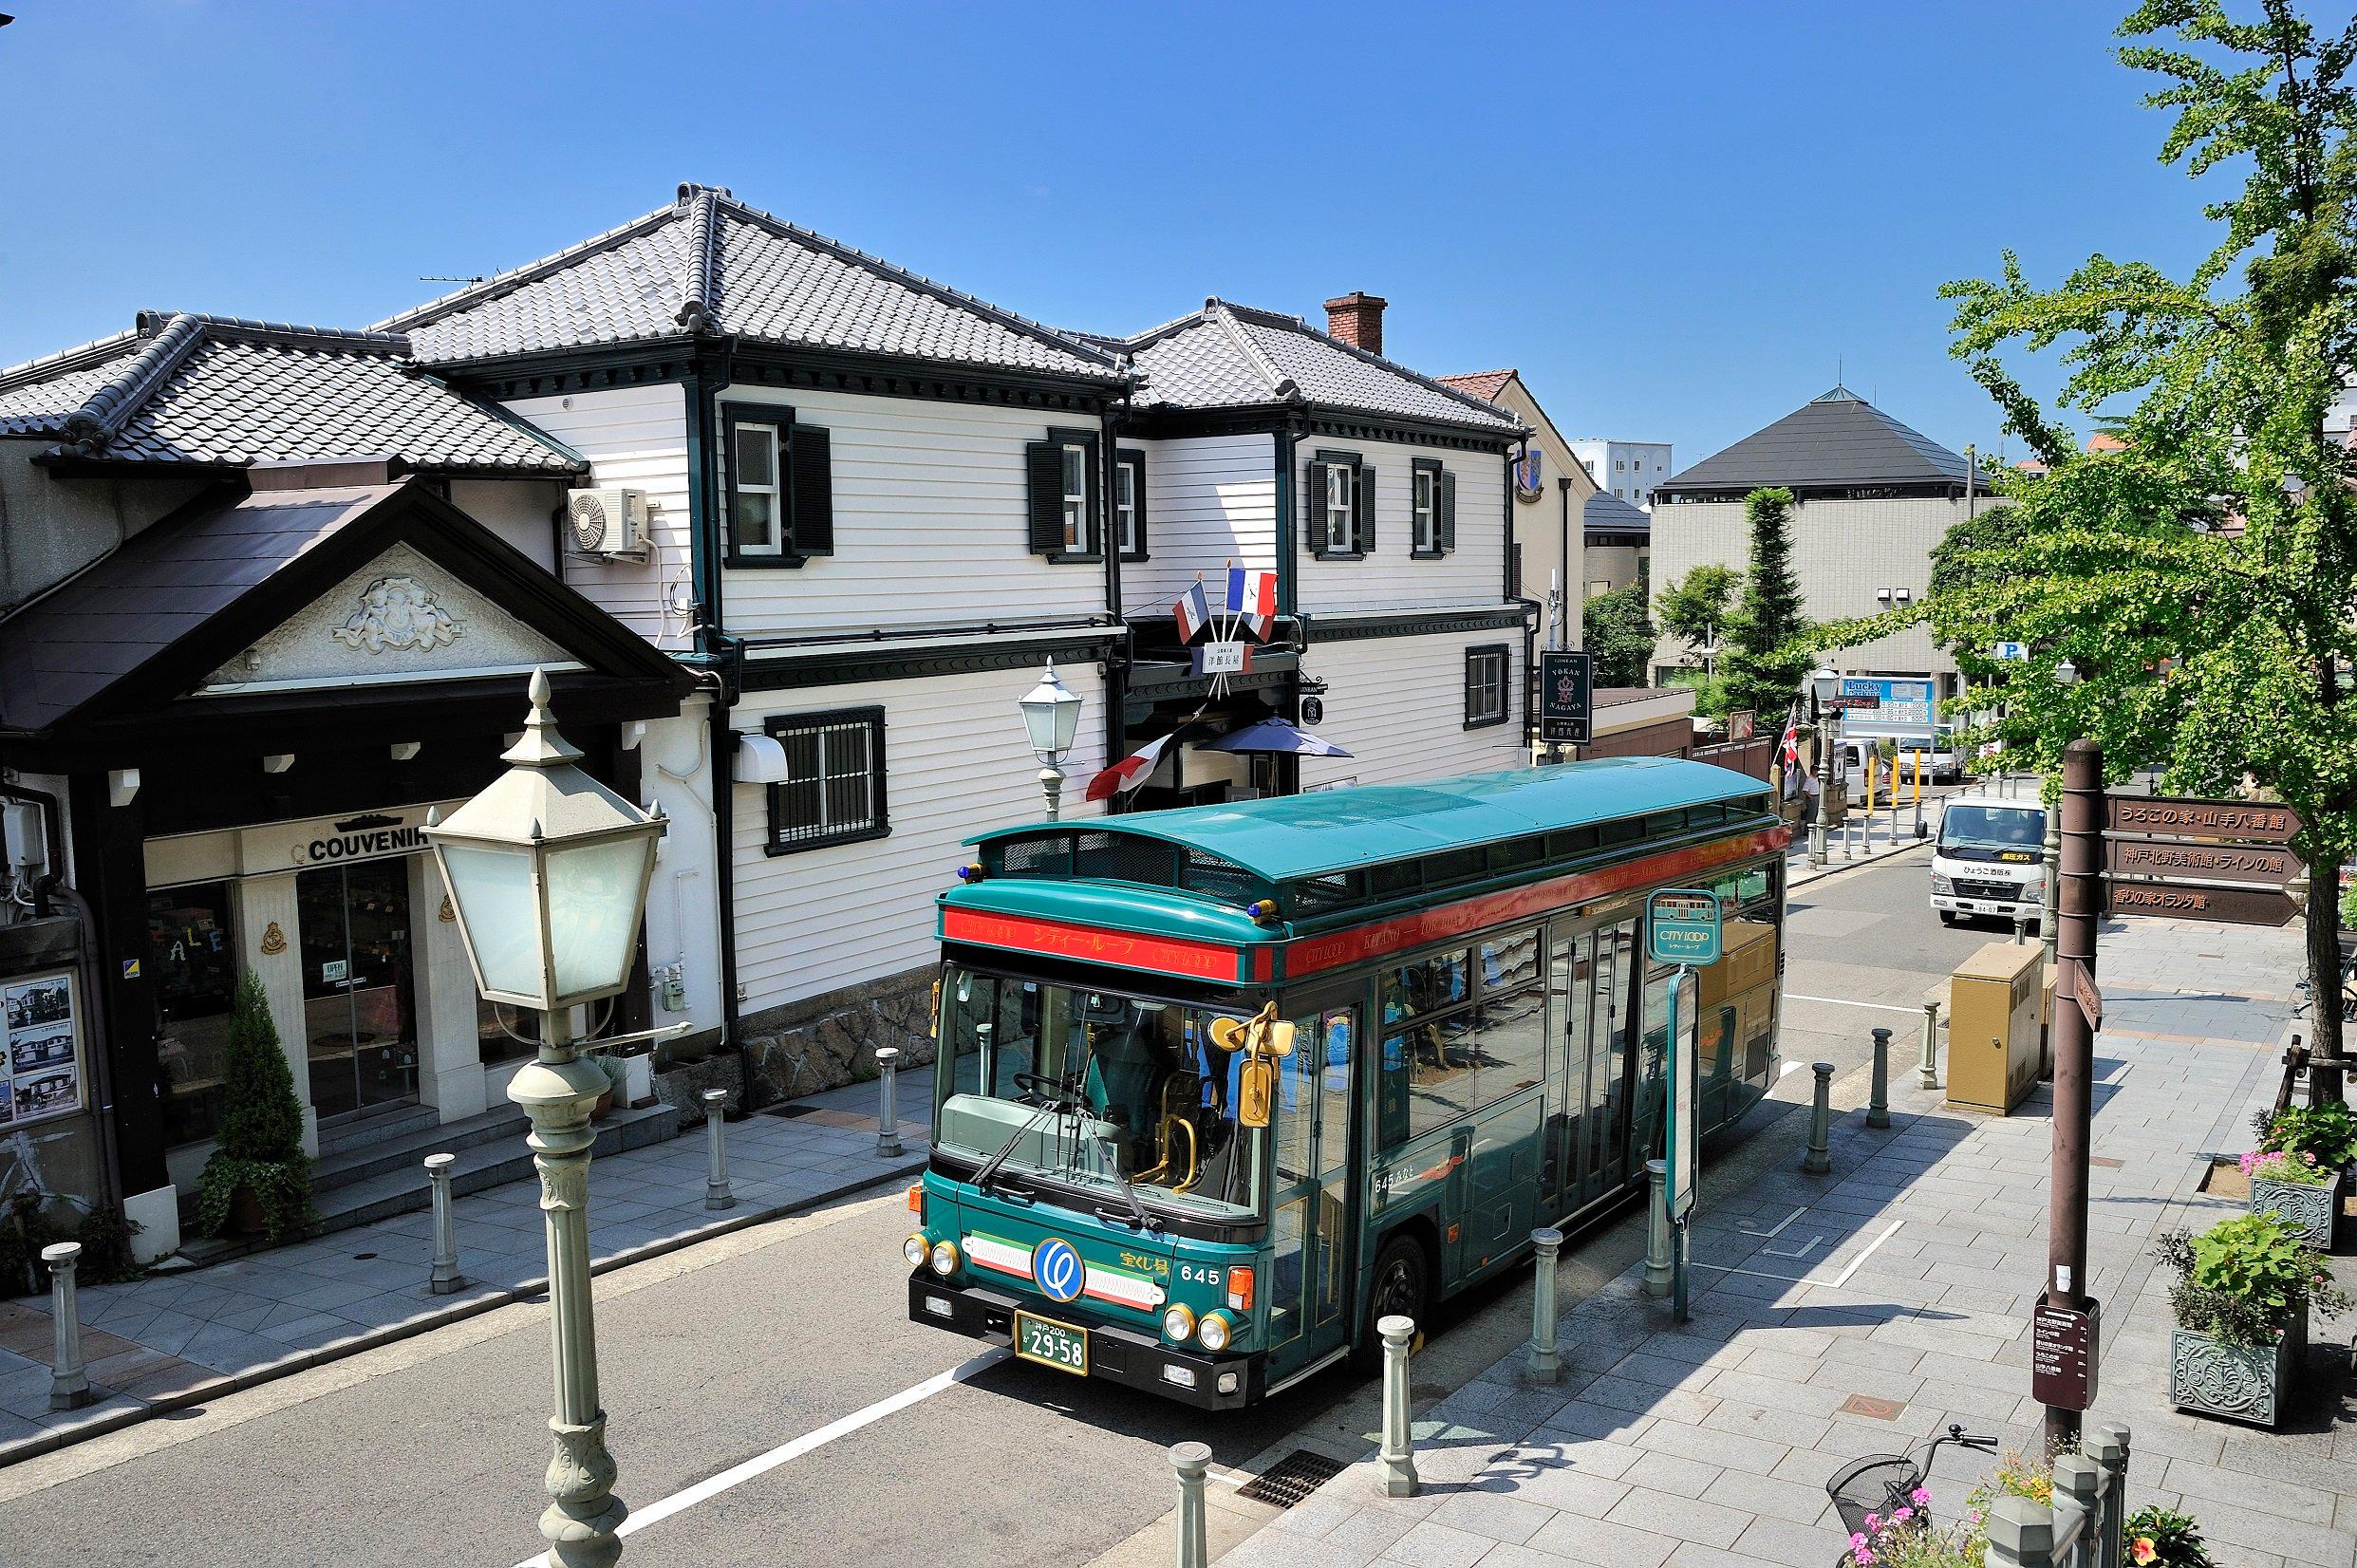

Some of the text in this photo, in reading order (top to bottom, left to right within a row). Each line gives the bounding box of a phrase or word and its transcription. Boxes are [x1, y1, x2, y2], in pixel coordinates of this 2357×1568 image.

[2004, 644, 2018, 657] P
[1848, 681, 1882, 692] Lucky
[1549, 702, 1581, 711] NAGAYA
[2121, 807, 2286, 830] うろこの家・山手八番館
[2123, 848, 2284, 872] 神戸北野美術館・ラインの館
[960, 918, 1018, 940] CITY LOOP
[1364, 927, 1401, 950] KITANO
[1659, 930, 1710, 942] CITY LOOP
[1152, 947, 1217, 969] CITY LOOP
[1375, 1173, 1394, 1193] 645
[1120, 1252, 1169, 1276] 宝くじ号
[1181, 1265, 1220, 1285] 645
[1031, 1330, 1082, 1366] 29-58
